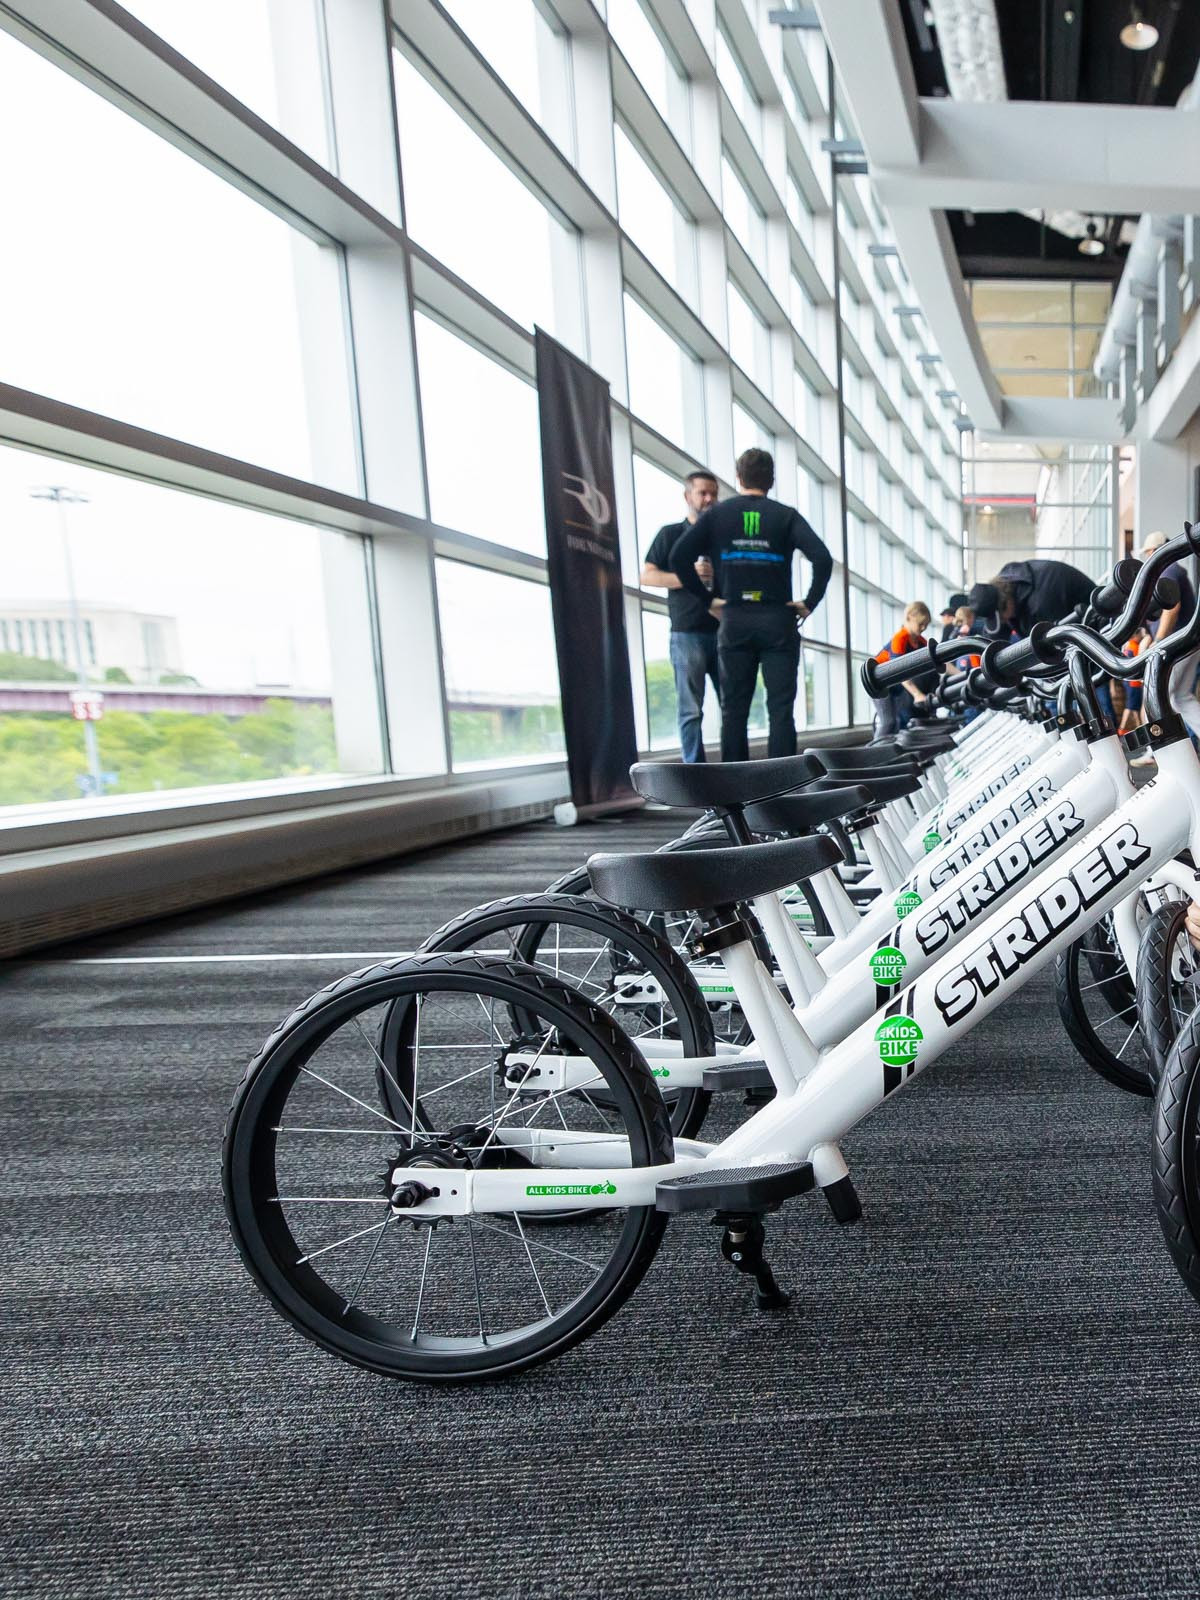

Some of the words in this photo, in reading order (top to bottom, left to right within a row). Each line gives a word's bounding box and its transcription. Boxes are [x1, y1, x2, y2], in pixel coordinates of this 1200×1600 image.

[929, 776, 1058, 892] STRIDER
[916, 800, 1086, 956] STRIDER
[934, 823, 1152, 1028] STRIDER
[878, 955, 903, 965] KIDS
[872, 966, 903, 978] BIKE
[887, 1026, 918, 1039] KIDS
[879, 1040, 918, 1056] BIKE
[528, 1186, 544, 1195] ALL
[545, 1186, 566, 1194] KIDS
[567, 1186, 588, 1194] BIKE
